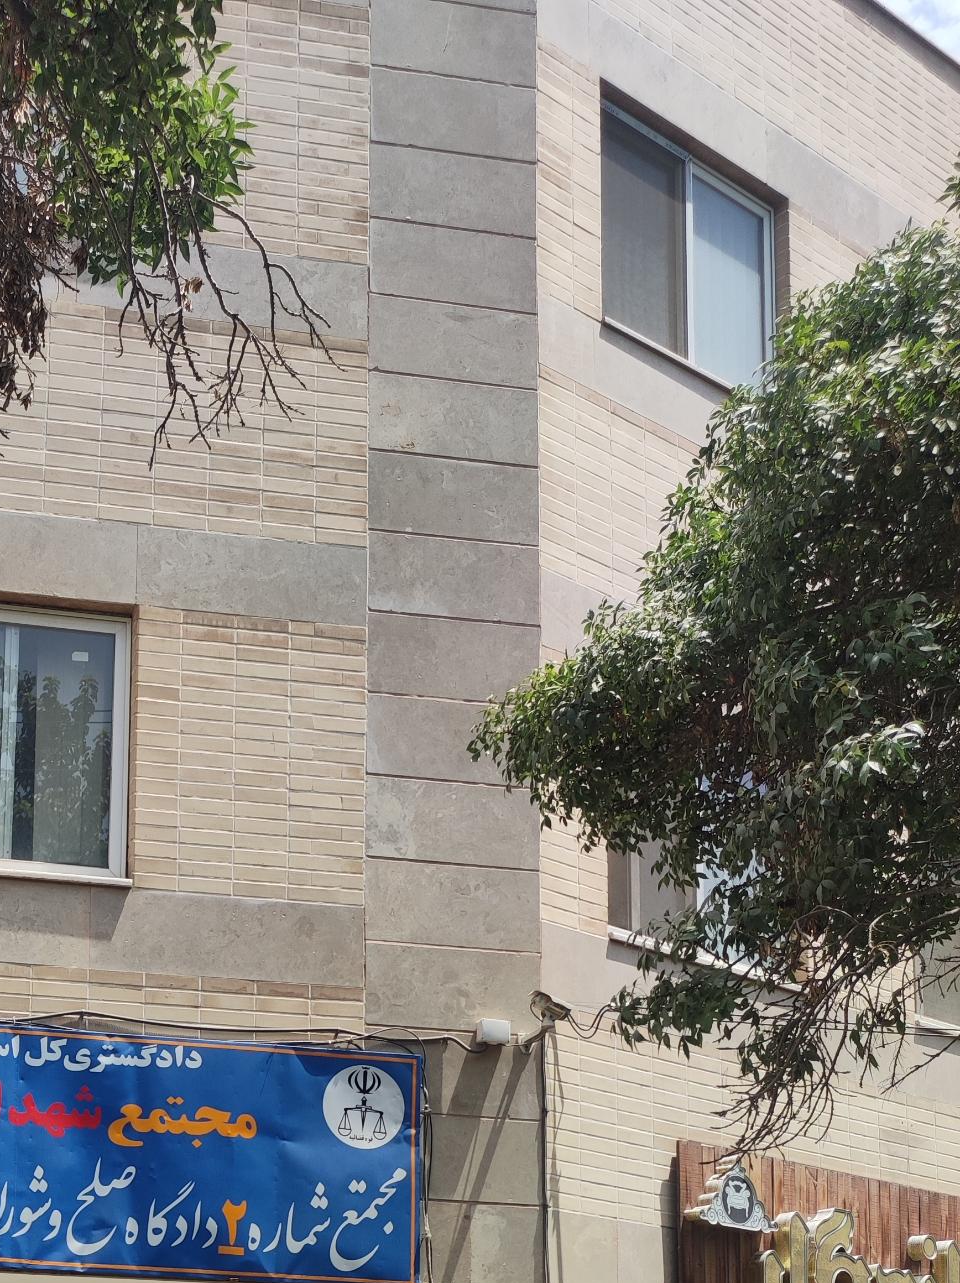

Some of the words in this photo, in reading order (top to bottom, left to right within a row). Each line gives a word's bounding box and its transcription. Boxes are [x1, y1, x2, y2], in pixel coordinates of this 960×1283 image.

[24, 1034, 68, 1068] کل
[62, 1044, 203, 1073] دادگستری
[107, 1094, 258, 1149] مجتمع
[65, 1156, 137, 1257] صلح
[124, 1180, 219, 1249] دادگاه
[220, 1198, 248, 1247] ۲
[247, 1181, 332, 1255] شماره
[329, 1166, 408, 1273] مجتمع
